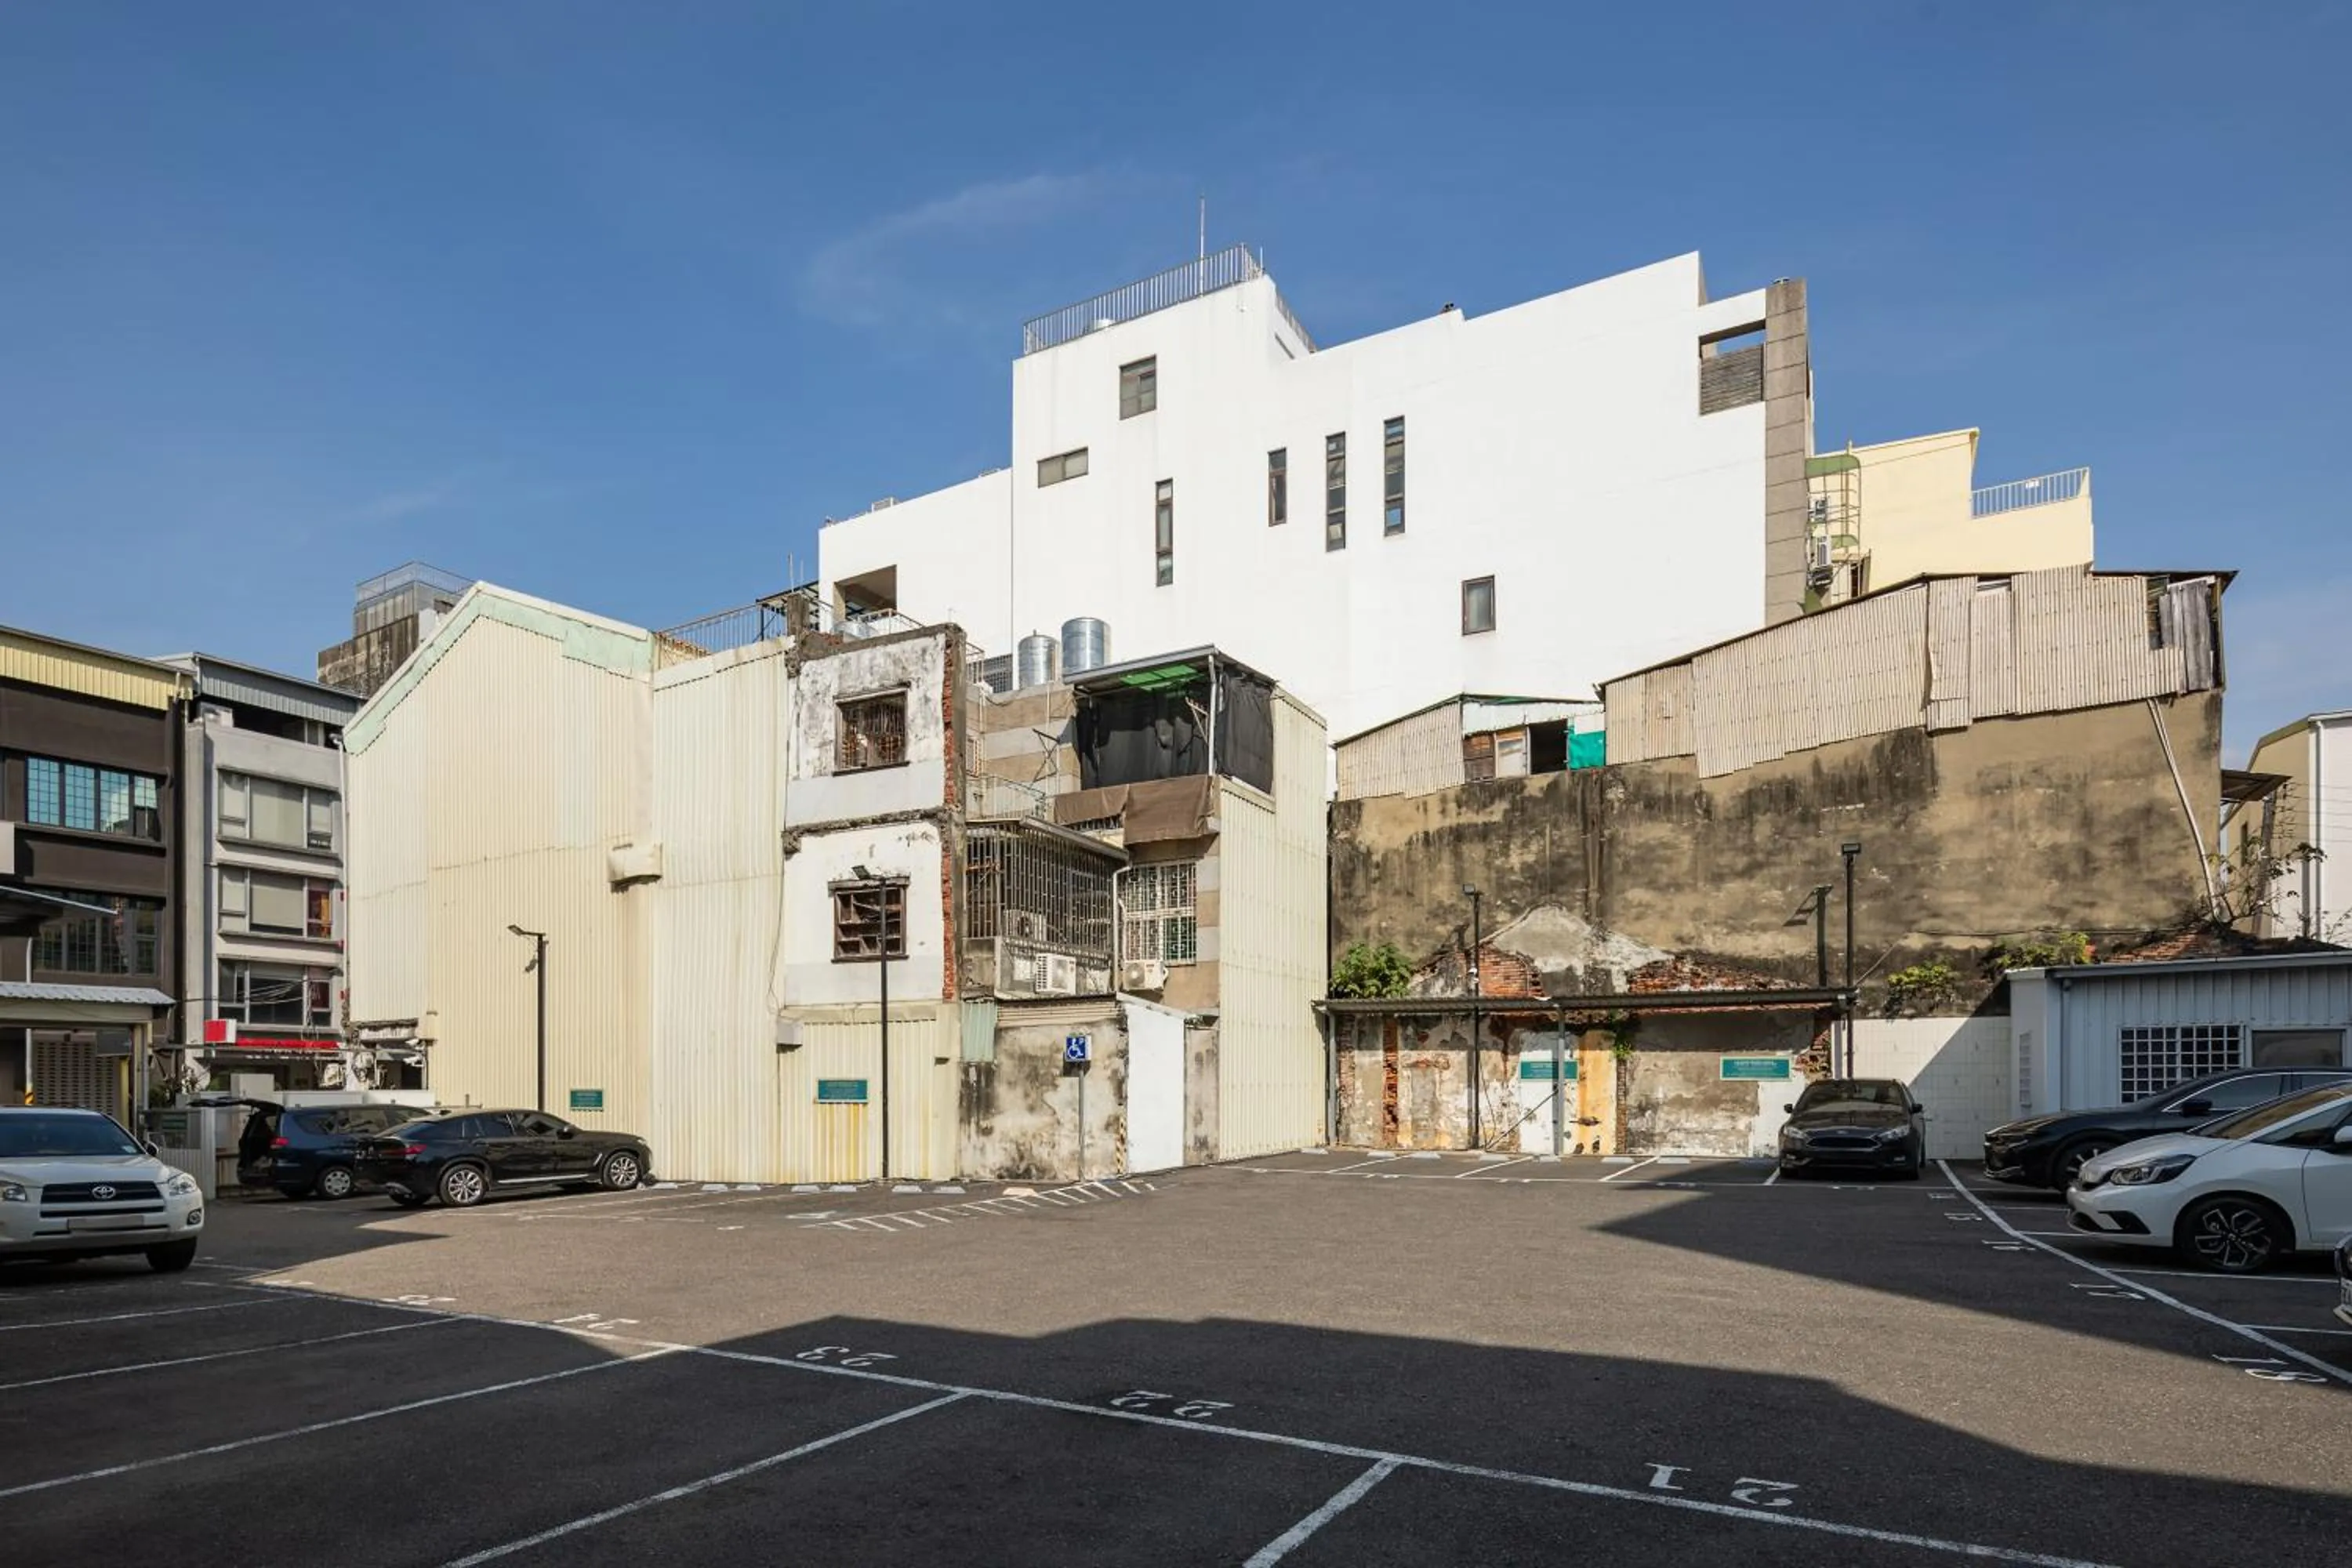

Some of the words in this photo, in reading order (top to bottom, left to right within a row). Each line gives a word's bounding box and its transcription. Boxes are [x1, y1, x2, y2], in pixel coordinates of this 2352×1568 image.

[796, 1345, 899, 1367] 23
[1109, 1389, 1236, 1418] 22
[1645, 1462, 1799, 1506] 21
